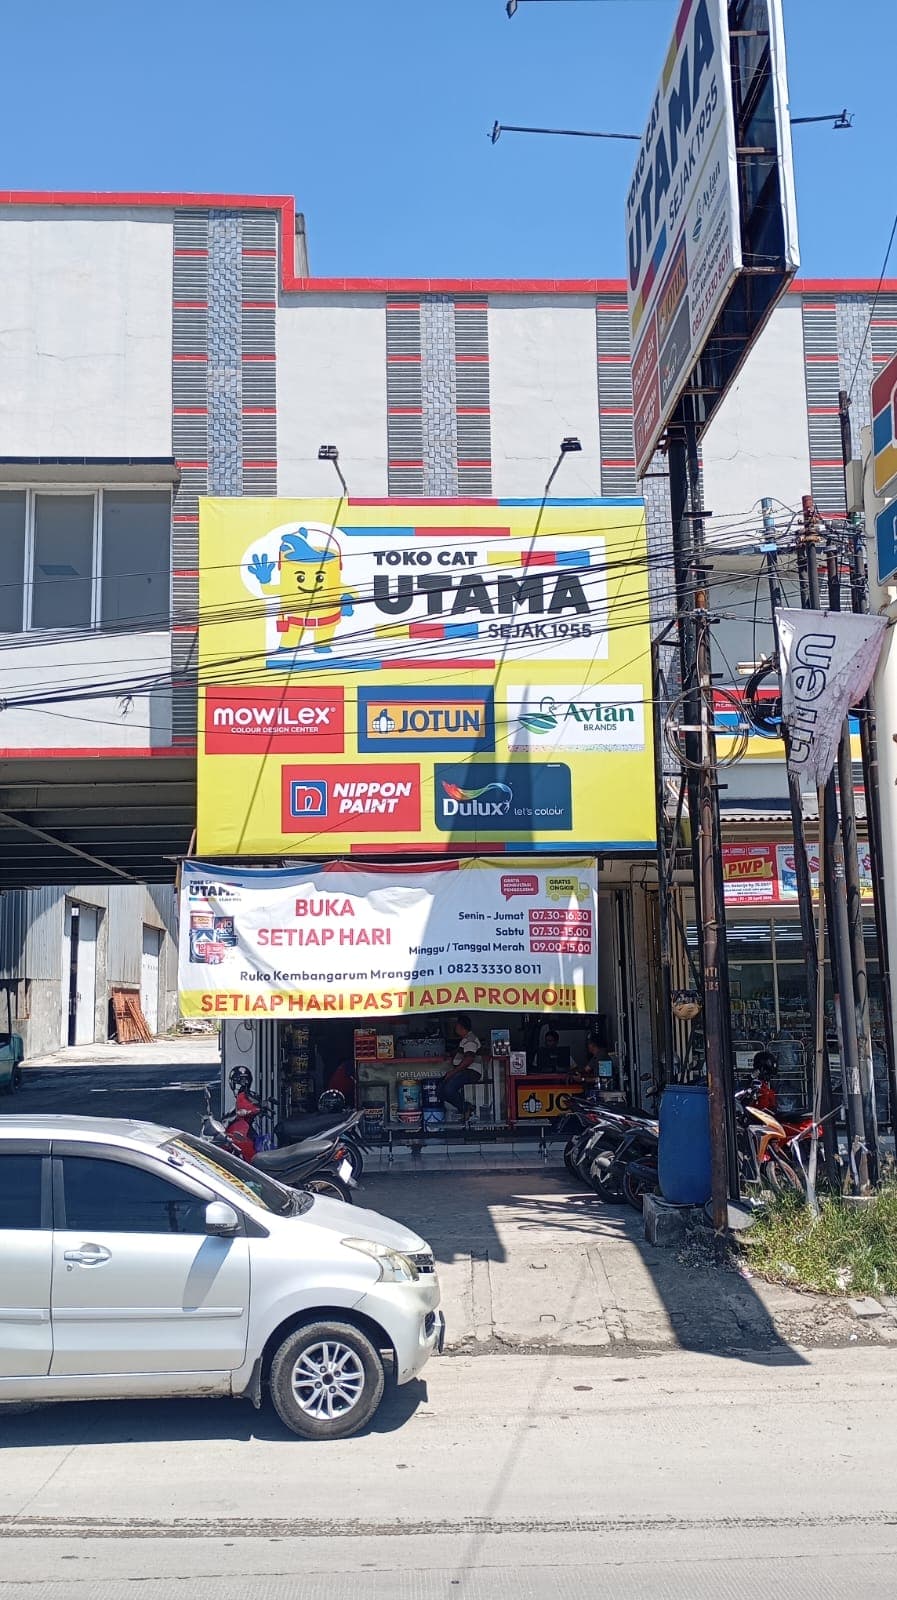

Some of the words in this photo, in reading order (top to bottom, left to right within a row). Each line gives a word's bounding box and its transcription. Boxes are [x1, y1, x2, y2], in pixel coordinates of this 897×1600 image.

[628, 0, 715, 291] UTAMA
[669, 137, 696, 231] SEJAK
[696, 74, 718, 154] 1955
[627, 147, 645, 219] TOKO
[646, 89, 660, 153] CAT
[373, 551, 432, 566] TOKO
[437, 551, 478, 566] CAT
[373, 574, 591, 615] UTAMA
[488, 623, 548, 639] SEJAK
[550, 623, 592, 638] 1955
[564, 702, 635, 722] Avian
[400, 709, 480, 732] JOTUN
[333, 782, 412, 798] NIPPON
[339, 799, 399, 814] PAINT
[442, 798, 504, 816] Dulux
[514, 807, 533, 815] let's
[534, 807, 564, 816] colour
[728, 860, 763, 875] PWP
[189, 885, 236, 897] UTAM
[295, 899, 355, 917] BUKA
[458, 911, 485, 921] Senin
[493, 911, 524, 921] Jumat
[257, 928, 335, 946] SETIAP
[339, 927, 391, 945] HARI
[495, 927, 524, 936] Sabtu
[532, 927, 589, 937] 07.30-15.00
[409, 945, 445, 956] Minggu
[452, 942, 491, 952] Tanggal
[493, 942, 525, 951] Merah
[532, 942, 590, 953] 09.00-15.00
[240, 971, 271, 981] Ruko
[273, 971, 368, 983] Kembangarum
[370, 968, 435, 981] Mranggen
[447, 963, 479, 974] 0823
[480, 964, 512, 975] 3330
[514, 964, 542, 975] 8011
[201, 994, 289, 1012] SETIAP
[289, 994, 344, 1011] HARI
[350, 991, 414, 1010] PASTI
[419, 987, 471, 1007] ADA
[474, 987, 577, 1007] PROMO!!!
